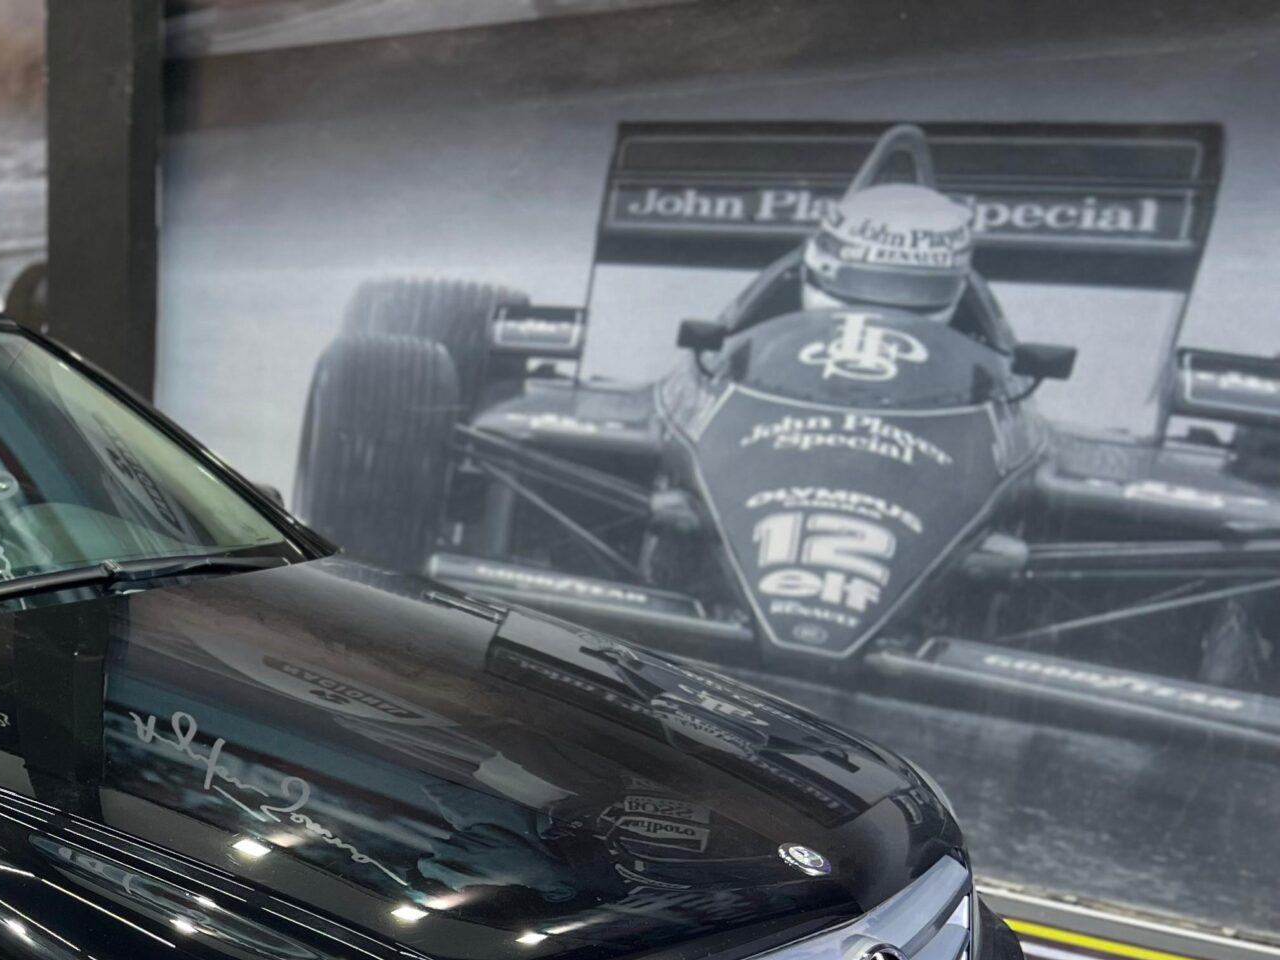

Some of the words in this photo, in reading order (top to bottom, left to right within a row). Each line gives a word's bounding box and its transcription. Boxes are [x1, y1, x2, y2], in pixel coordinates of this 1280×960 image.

[627, 188, 744, 221] John
[967, 195, 1160, 234] pecial
[740, 414, 831, 448] John
[843, 413, 953, 466] Player
[773, 431, 914, 465] Special
[746, 486, 924, 535] OLYMPUS
[752, 511, 898, 588] 12
[757, 568, 882, 613] elf
